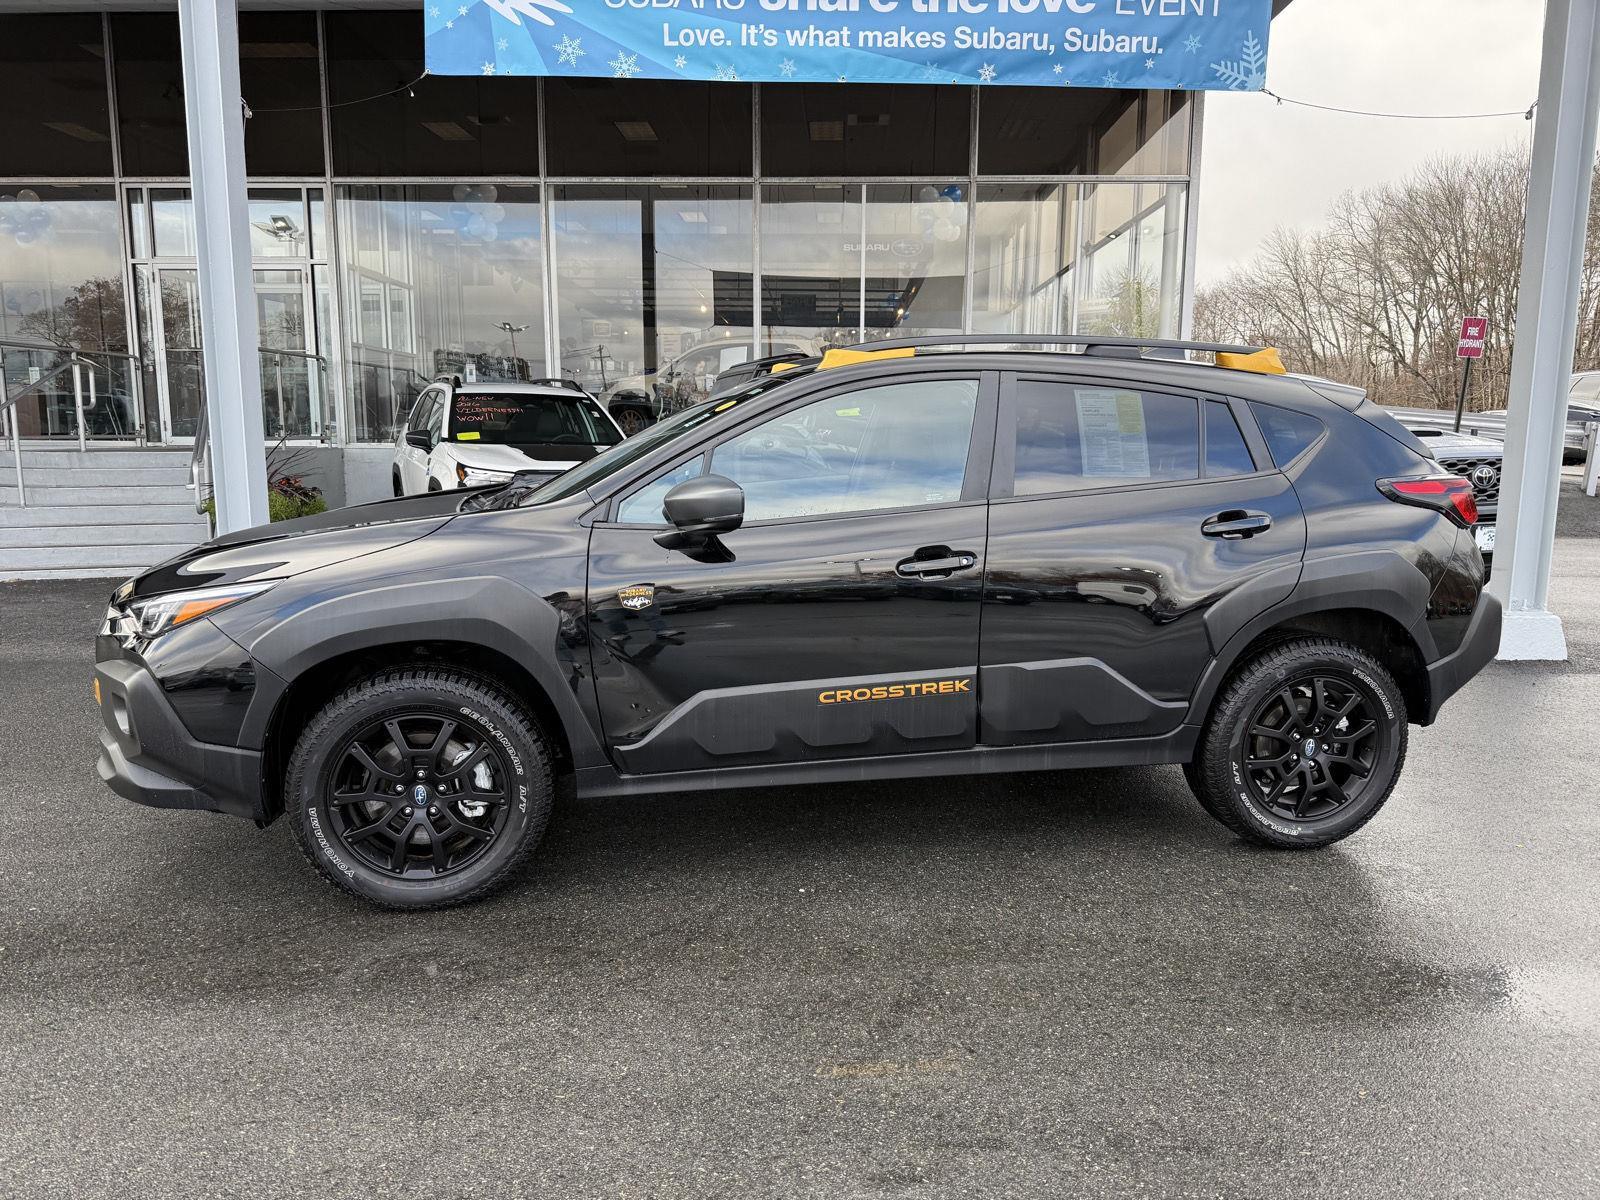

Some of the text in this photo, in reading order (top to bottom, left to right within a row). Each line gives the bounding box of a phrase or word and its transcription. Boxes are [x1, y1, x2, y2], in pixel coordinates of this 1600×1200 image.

[663, 23, 732, 47] Love.
[785, 25, 851, 48] what
[858, 26, 946, 49] makes
[954, 26, 1055, 55] Subaru,
[1063, 27, 1163, 54] Subaru.
[843, 243, 890, 251] SUARU
[1459, 339, 1483, 348] HYDRANT
[1467, 326, 1480, 336] FIRE
[818, 679, 971, 704] CROSSTREK
[1352, 668, 1395, 720] YOKOHAMA
[459, 706, 529, 813] GEOLANDAR A/T
[307, 807, 355, 879] YOKOHAMA
